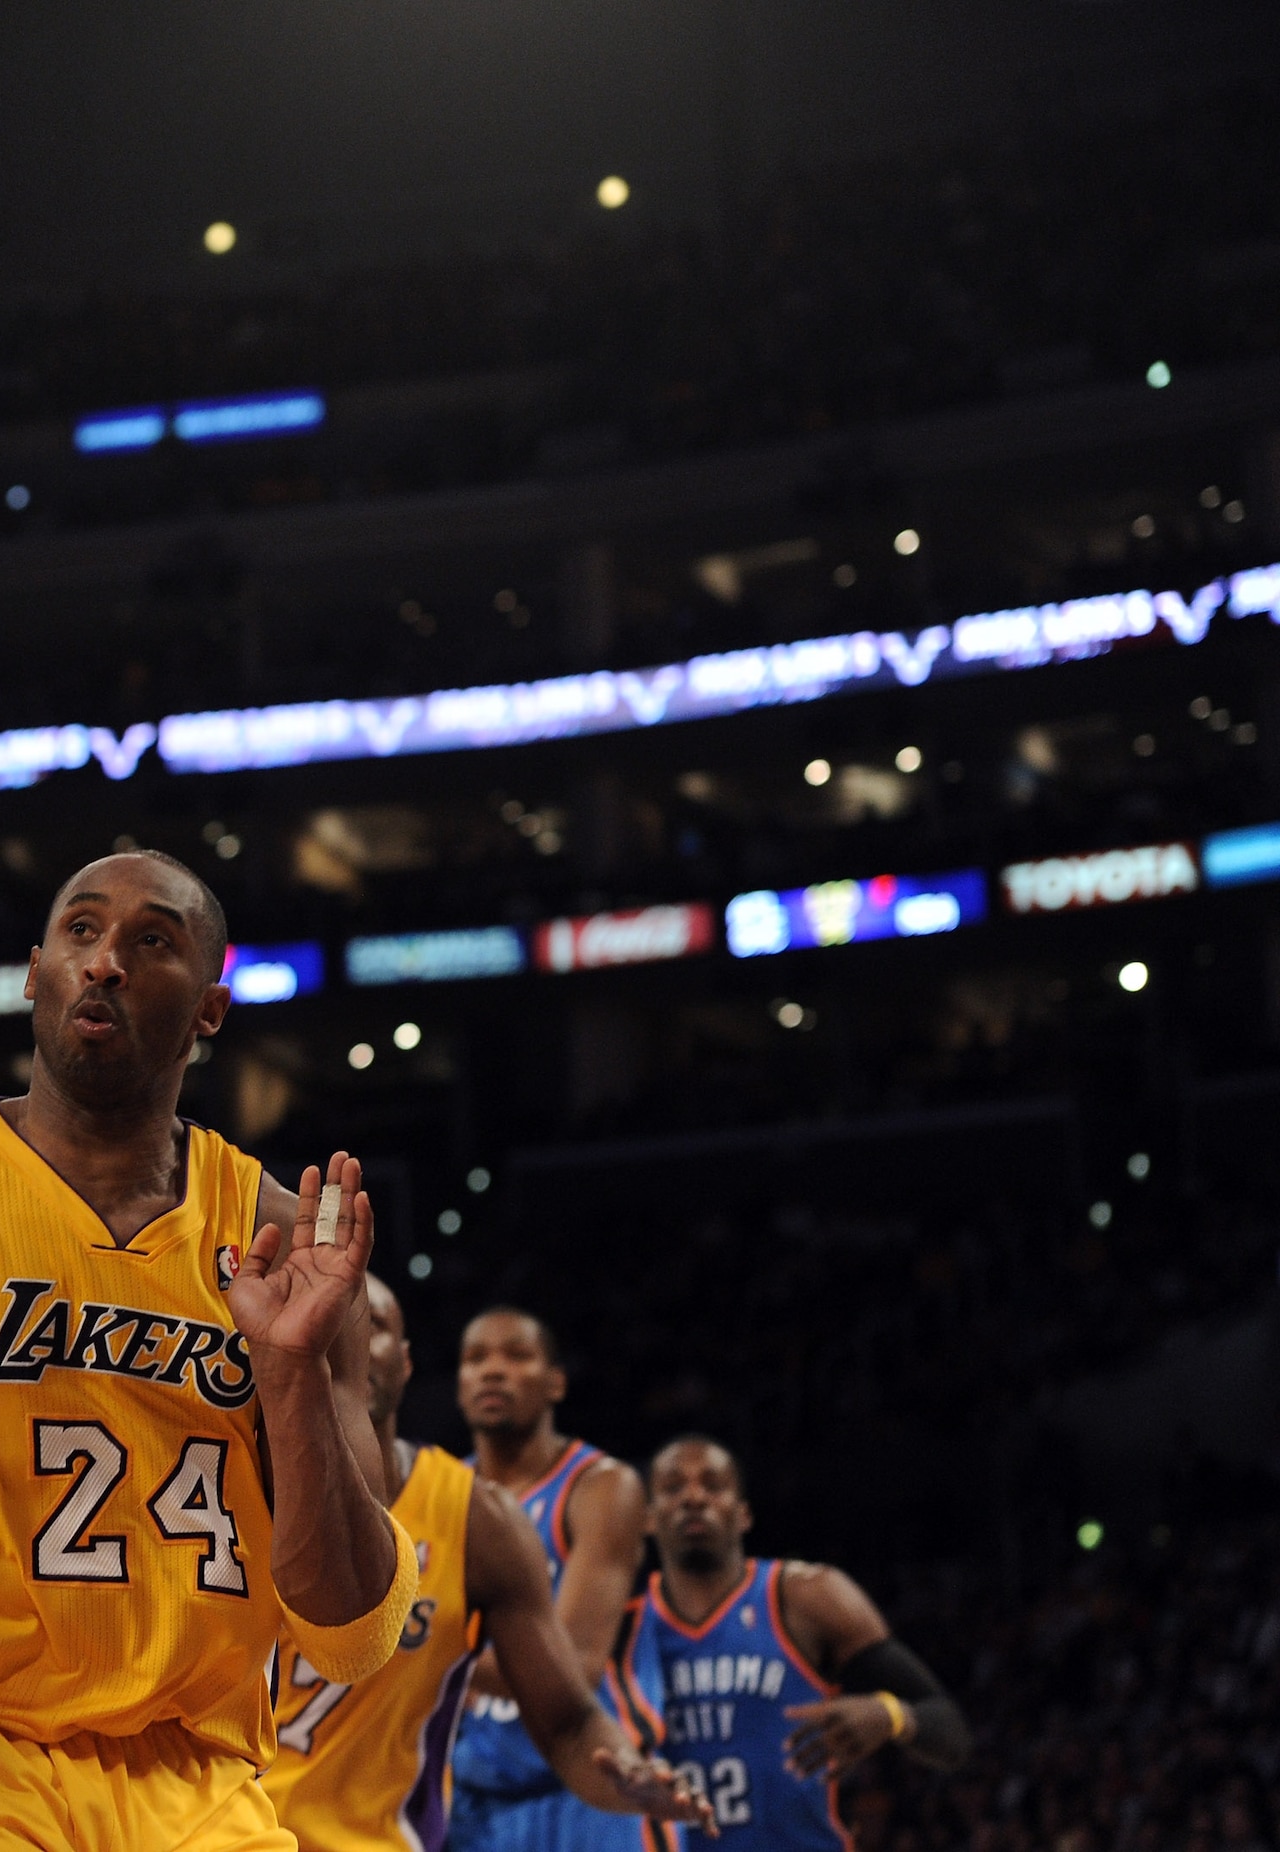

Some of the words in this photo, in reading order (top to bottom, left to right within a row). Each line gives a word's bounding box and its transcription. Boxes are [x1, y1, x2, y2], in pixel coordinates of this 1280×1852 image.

[1001, 843, 1198, 913] TOYOTA
[32, 1417, 250, 1599] 24
[666, 1654, 786, 1698] AHOMA
